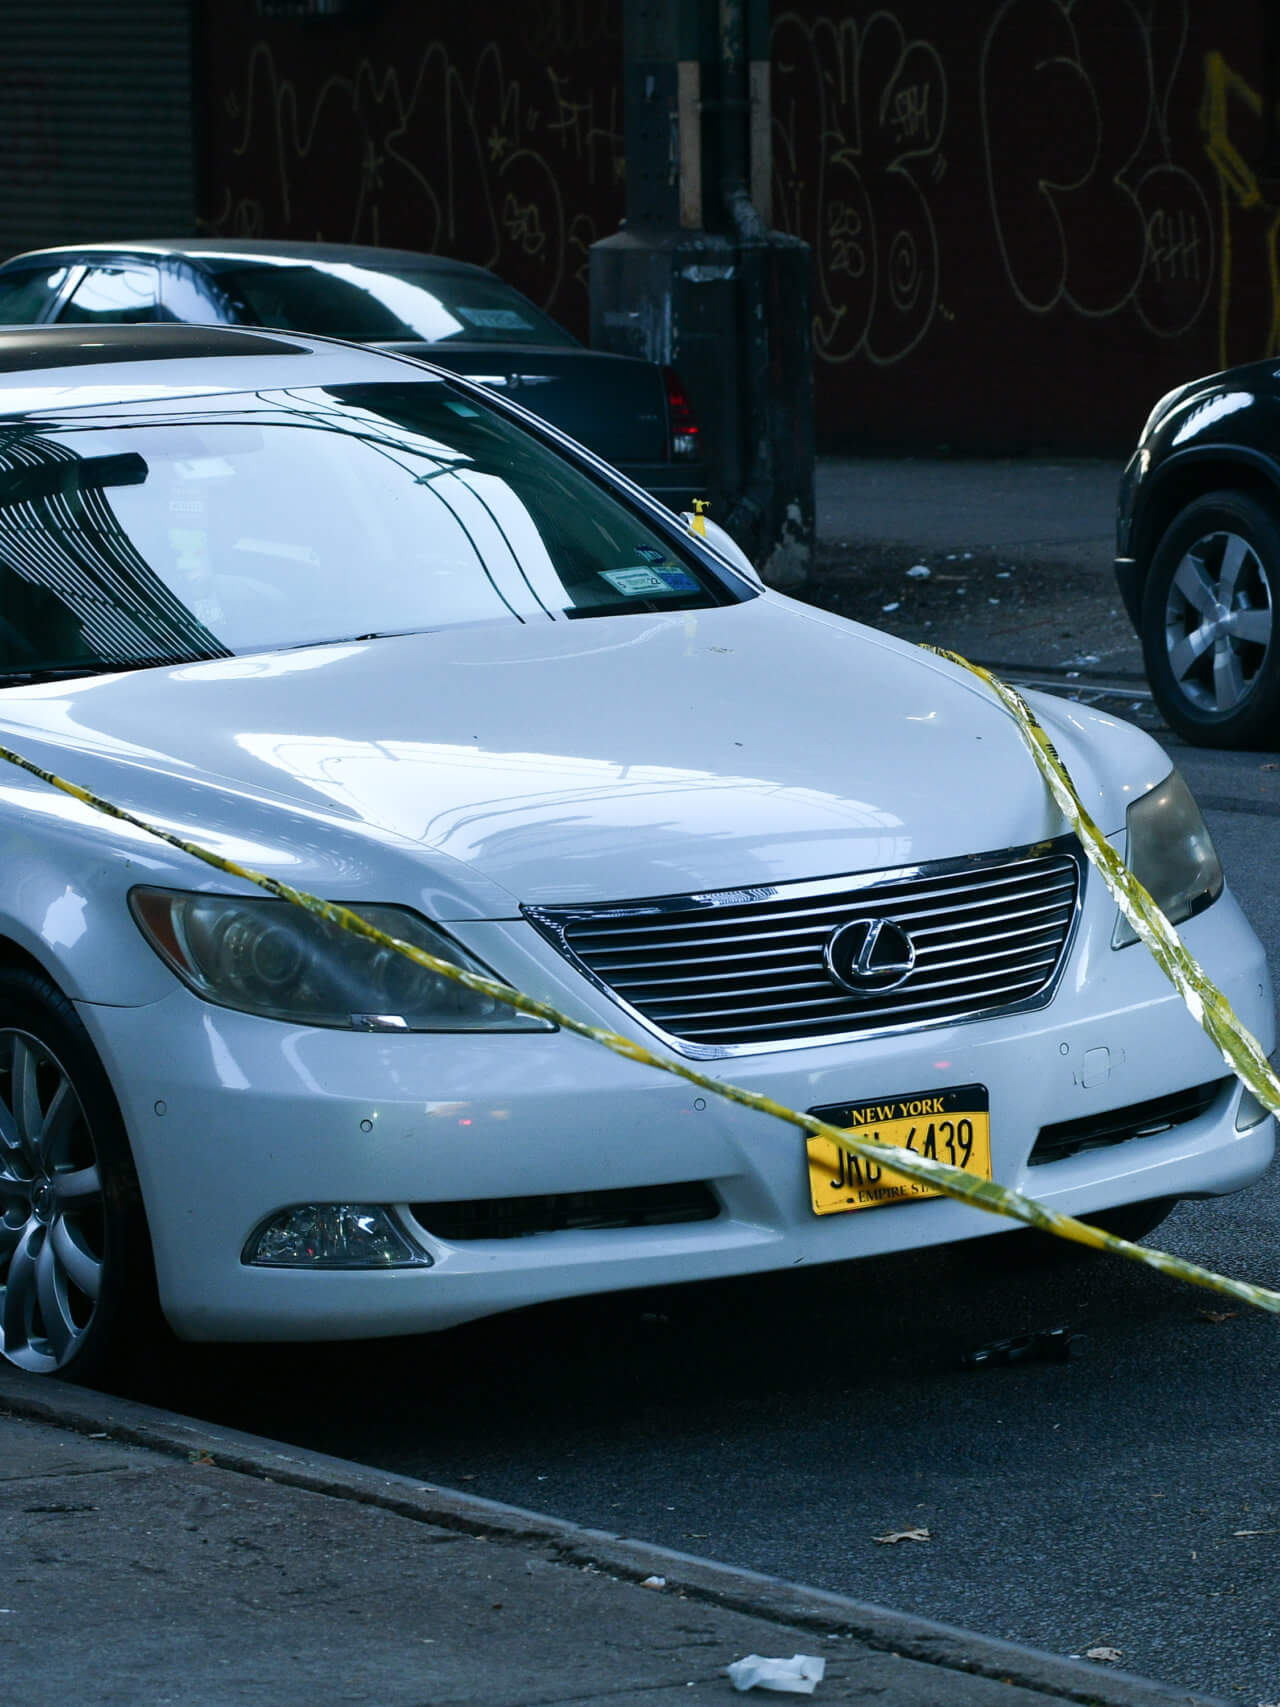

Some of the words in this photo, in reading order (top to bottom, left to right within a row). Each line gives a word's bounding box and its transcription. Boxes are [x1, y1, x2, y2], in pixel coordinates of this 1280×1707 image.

[852, 1104, 895, 1126] NEW
[899, 1097, 945, 1117] YORK
[858, 1185, 908, 1203] EMPIRE
